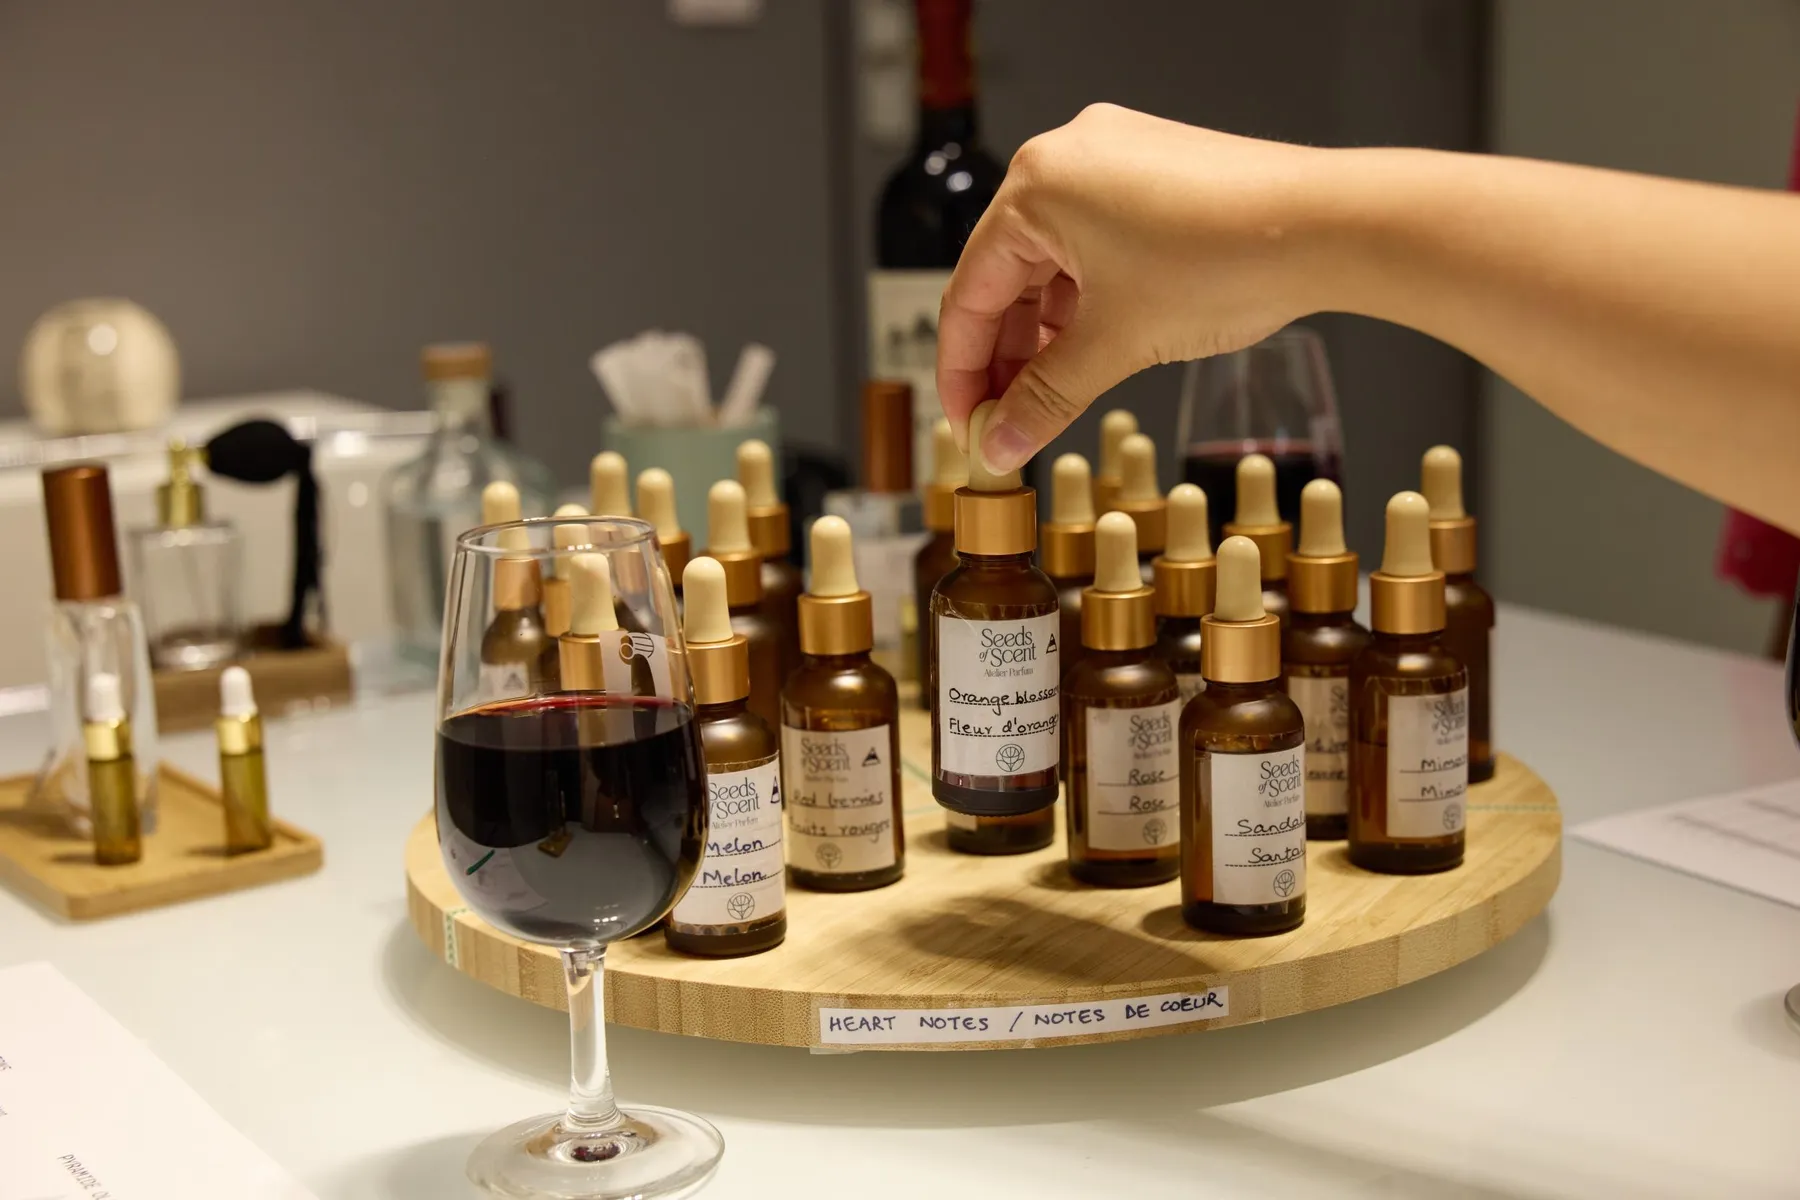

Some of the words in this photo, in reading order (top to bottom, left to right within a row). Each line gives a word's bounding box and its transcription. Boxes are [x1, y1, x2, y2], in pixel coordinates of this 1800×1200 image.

[981, 626, 1033, 648] Seeds
[979, 648, 990, 662] of
[990, 643, 1036, 667] Scent
[984, 668, 1008, 678] Atelier
[1009, 667, 1034, 677] Parfum
[949, 687, 1010, 716] Orange
[949, 717, 993, 735] Fleur
[1260, 754, 1300, 779] Seeds
[1128, 769, 1165, 786] Rose
[1258, 780, 1268, 794] of
[709, 777, 756, 801] Seeds
[828, 789, 883, 808] berries
[716, 793, 760, 819] Scent
[1129, 795, 1164, 813] Rose
[703, 868, 764, 886] Melon
[829, 1016, 896, 1033] HEART
[919, 1015, 989, 1033] NOTES
[1034, 1008, 1106, 1026] NOTES
[1125, 1003, 1150, 1019] DE
[1160, 992, 1224, 1014] COEUR
